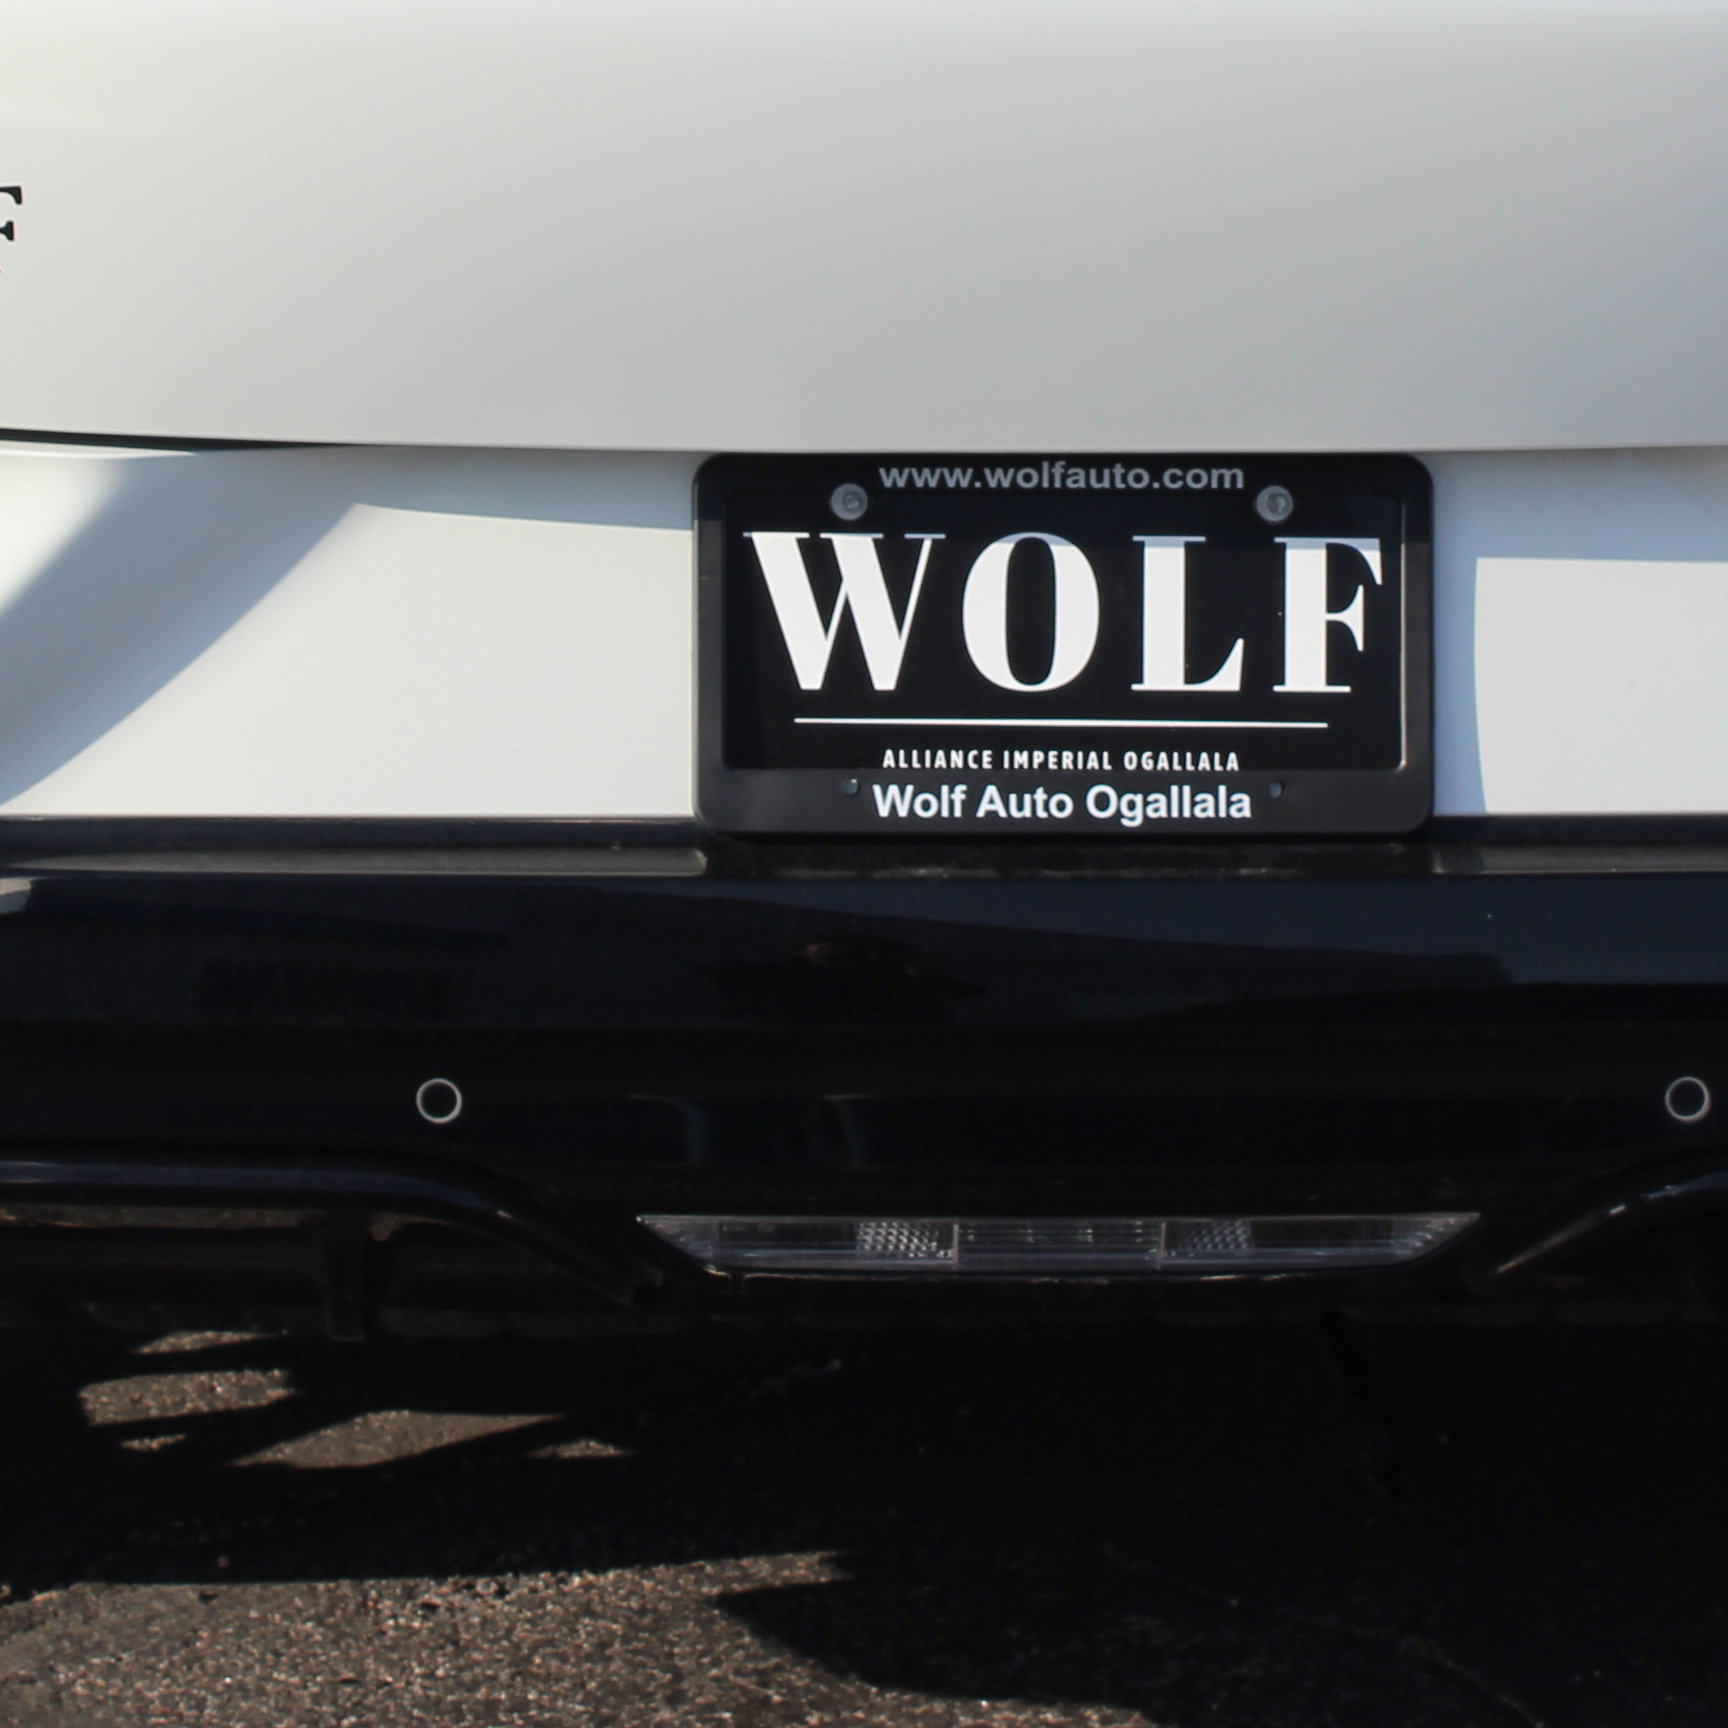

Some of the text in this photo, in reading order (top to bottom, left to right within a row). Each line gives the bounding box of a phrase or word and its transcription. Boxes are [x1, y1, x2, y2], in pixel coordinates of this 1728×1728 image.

[878, 461, 1245, 490] www.wolfauto.com
[742, 530, 1383, 694] WOLF
[882, 748, 1240, 772] ALLIANCE IMPERIAL OGALLALA
[872, 783, 1252, 828] Wolf Auto Ogallala
